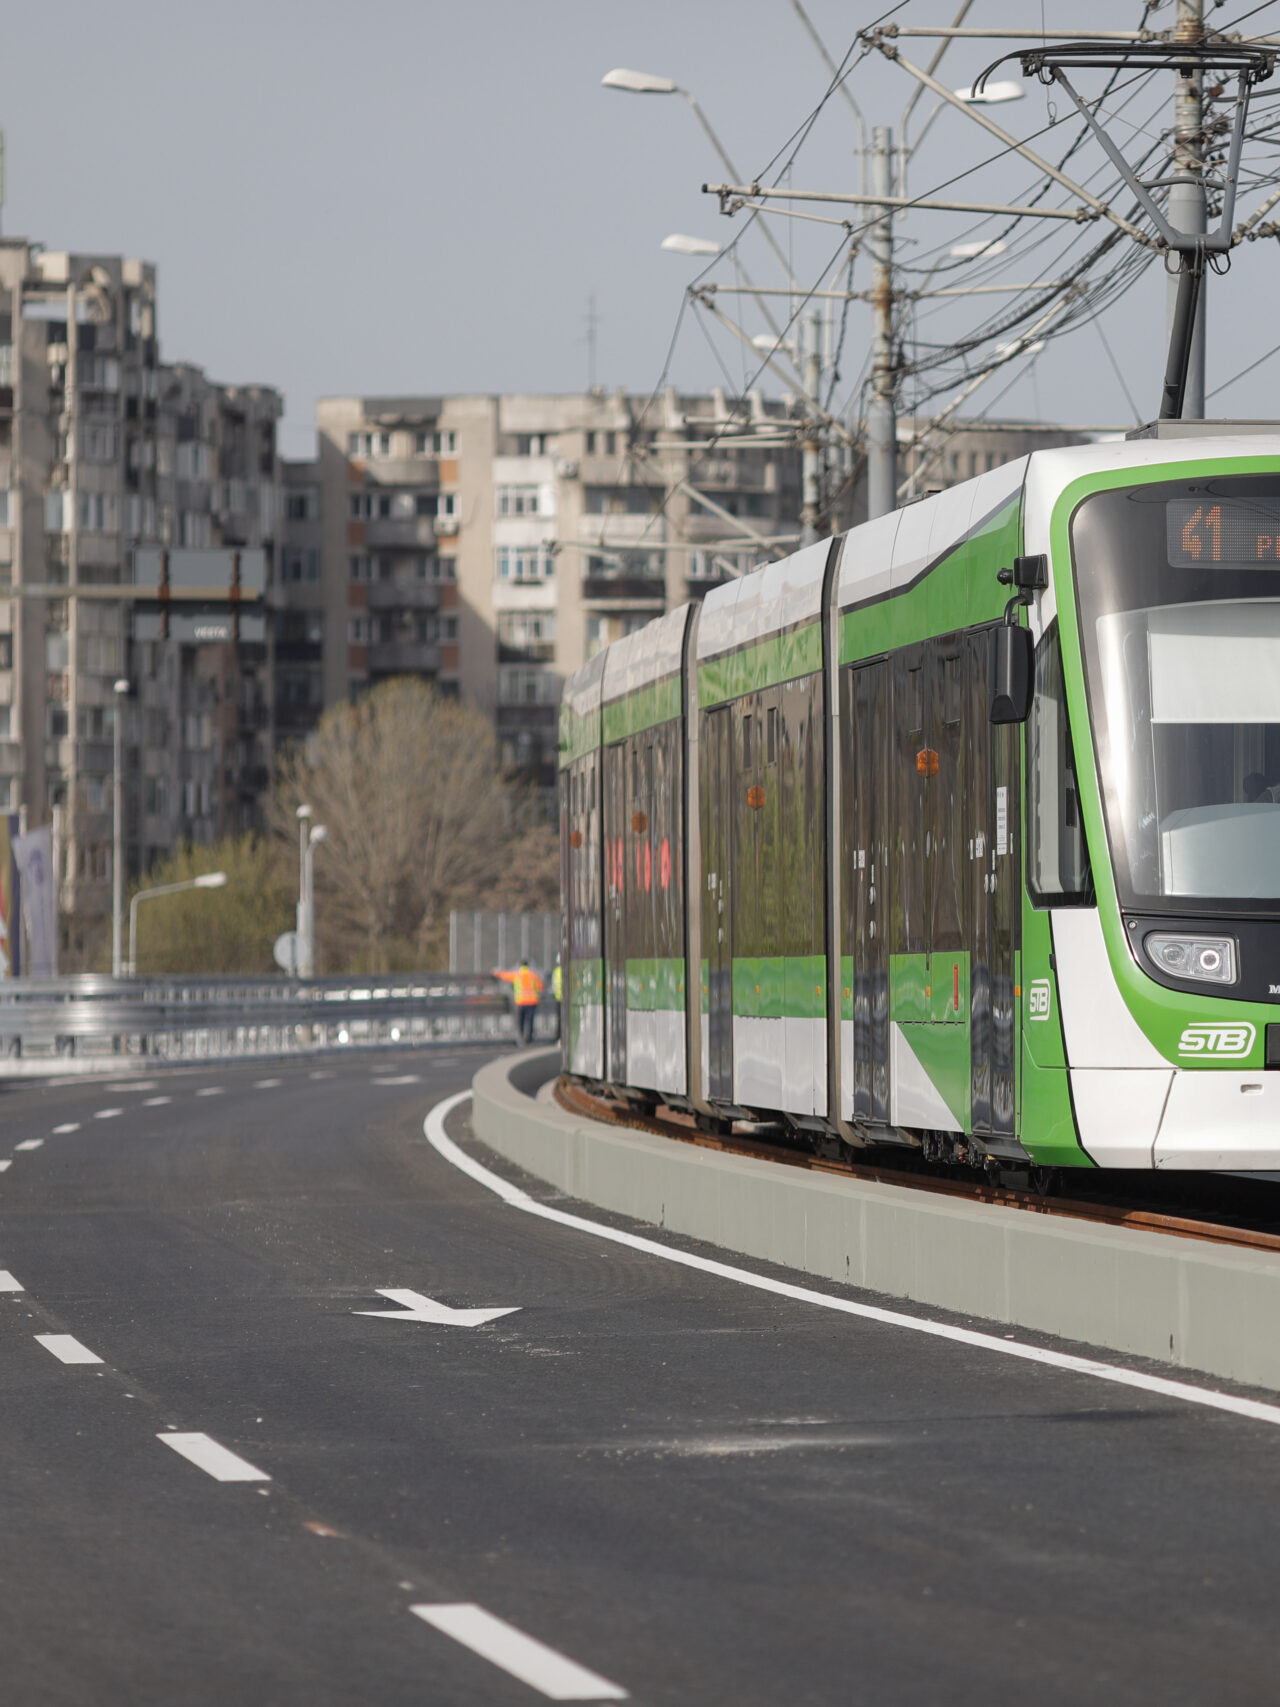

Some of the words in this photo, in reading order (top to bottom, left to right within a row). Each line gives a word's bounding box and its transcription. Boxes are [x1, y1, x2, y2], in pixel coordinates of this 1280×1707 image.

[1182, 506, 1221, 561] 41
[1030, 985, 1049, 1014] STB
[1178, 1027, 1250, 1053] STB
